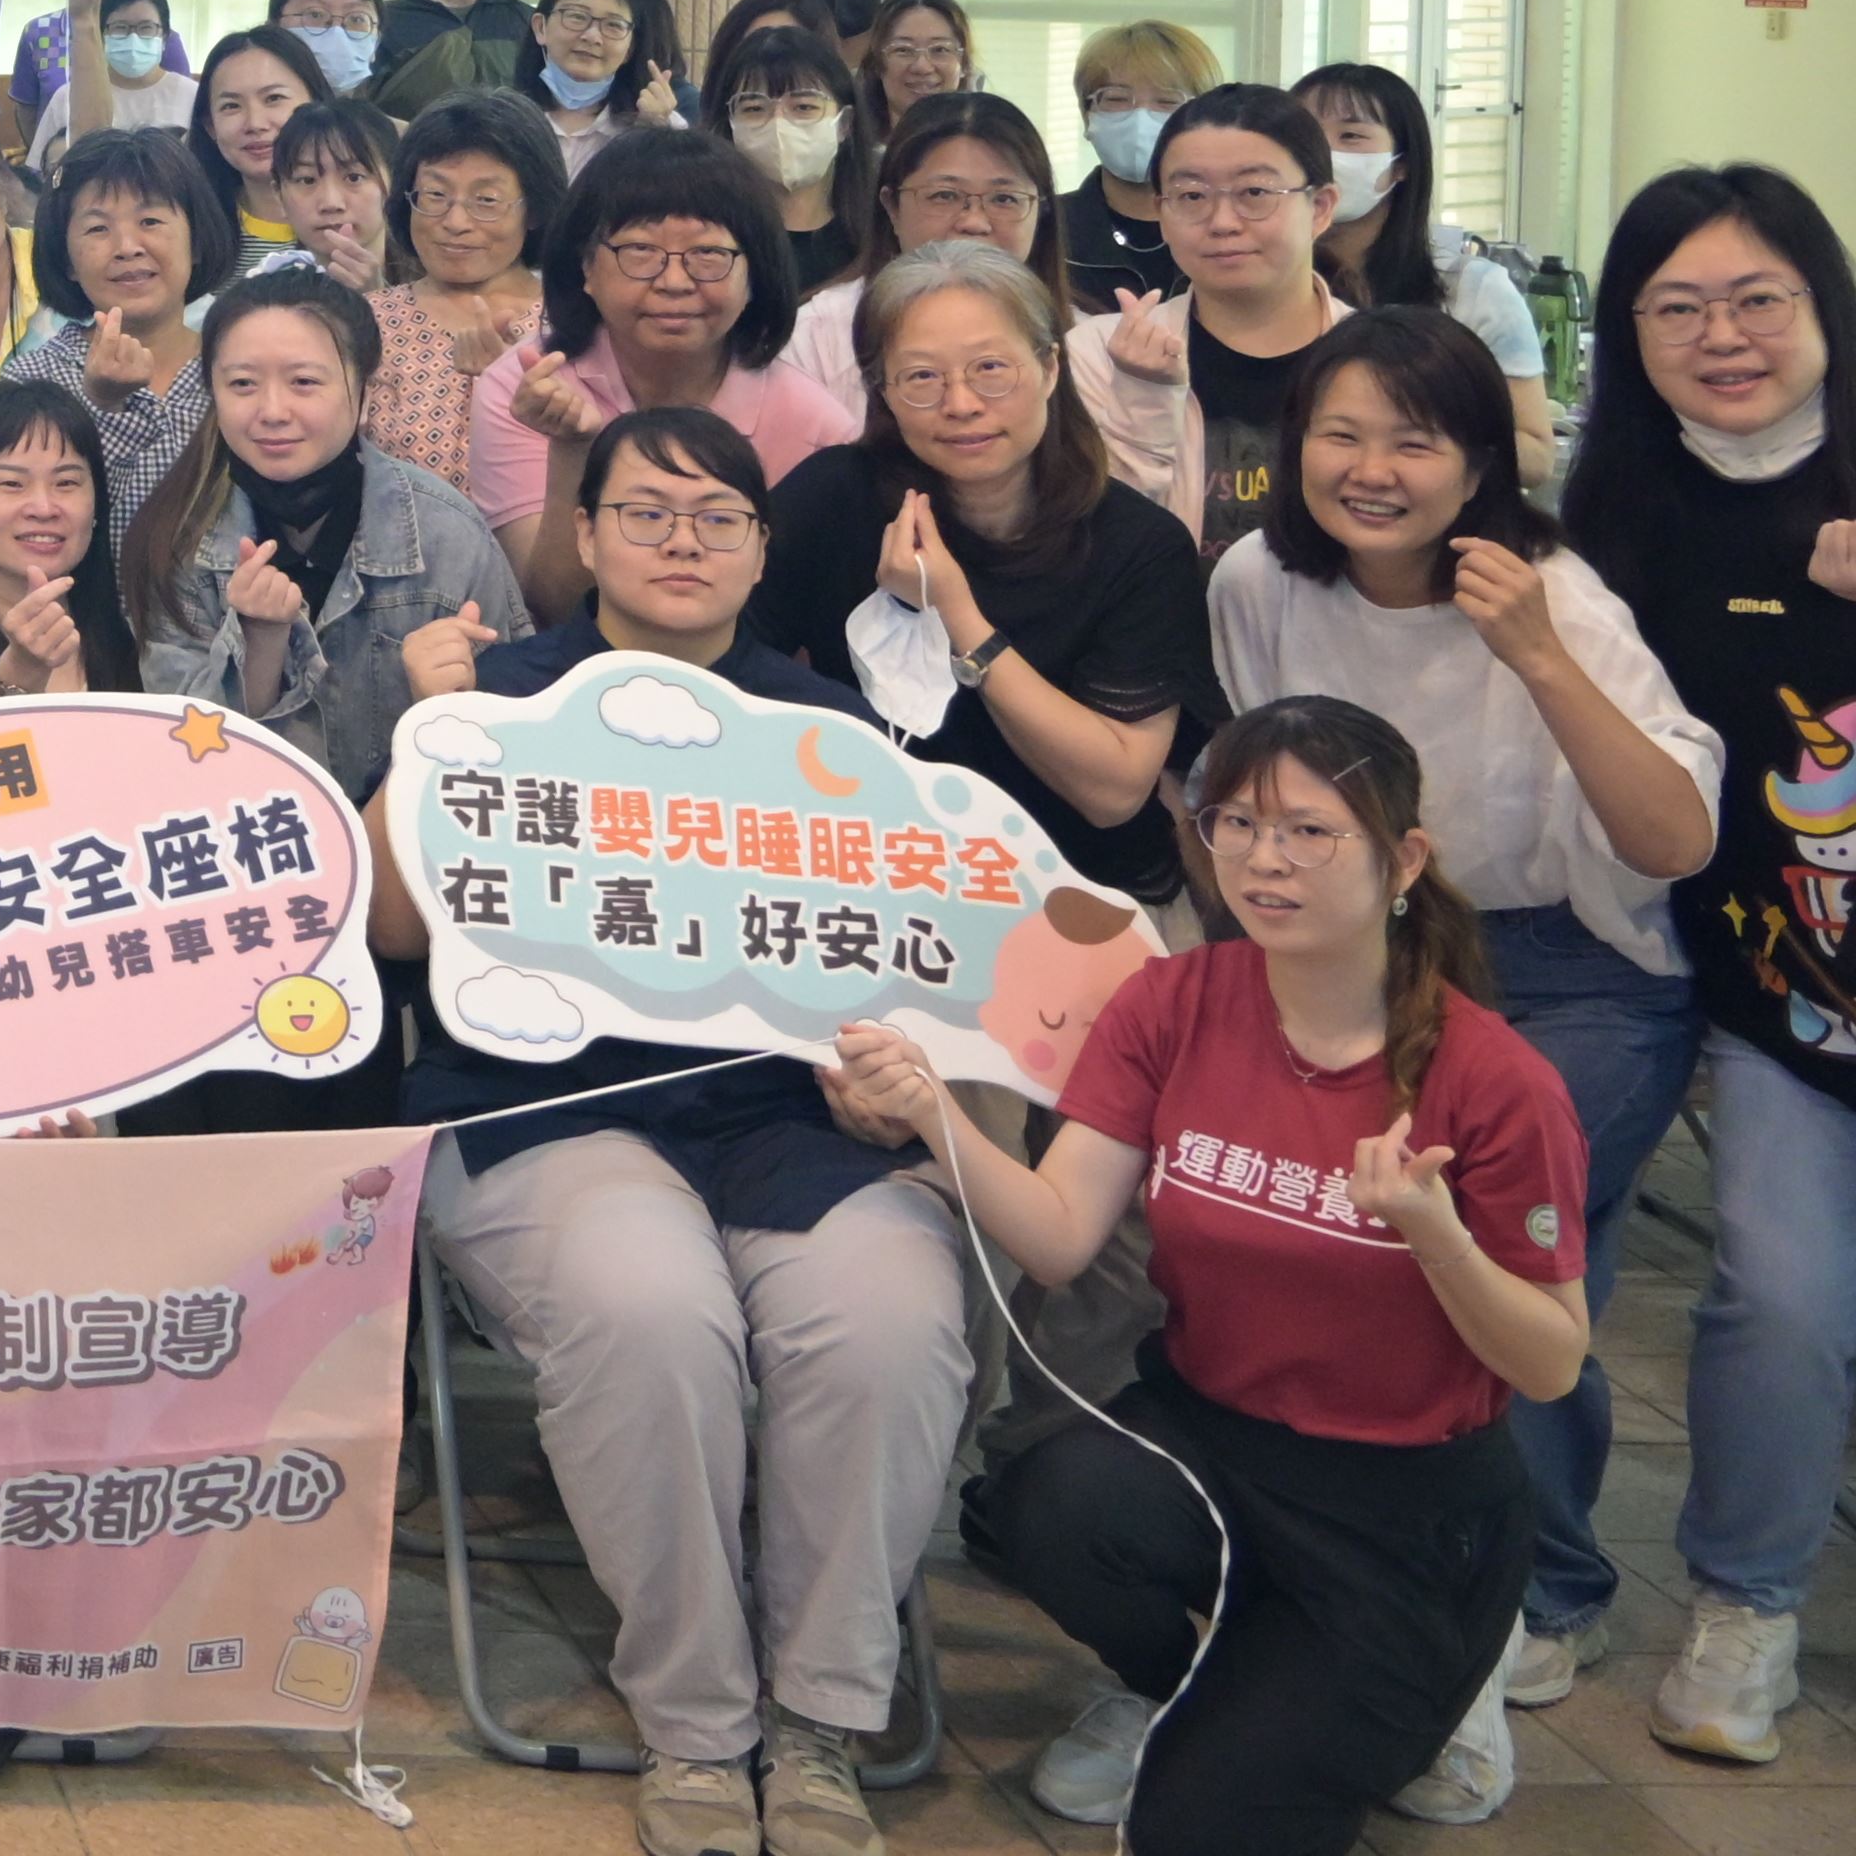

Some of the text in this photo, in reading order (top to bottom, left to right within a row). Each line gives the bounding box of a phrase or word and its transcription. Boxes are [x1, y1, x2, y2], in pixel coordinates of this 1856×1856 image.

[439, 769, 1026, 907] 守護嬰兒睡眠安全
[443, 857, 956, 984] 在「嘉」好安心
[1169, 1129, 1387, 1228] 運動營養
[191, 1640, 240, 1670] 廣告
